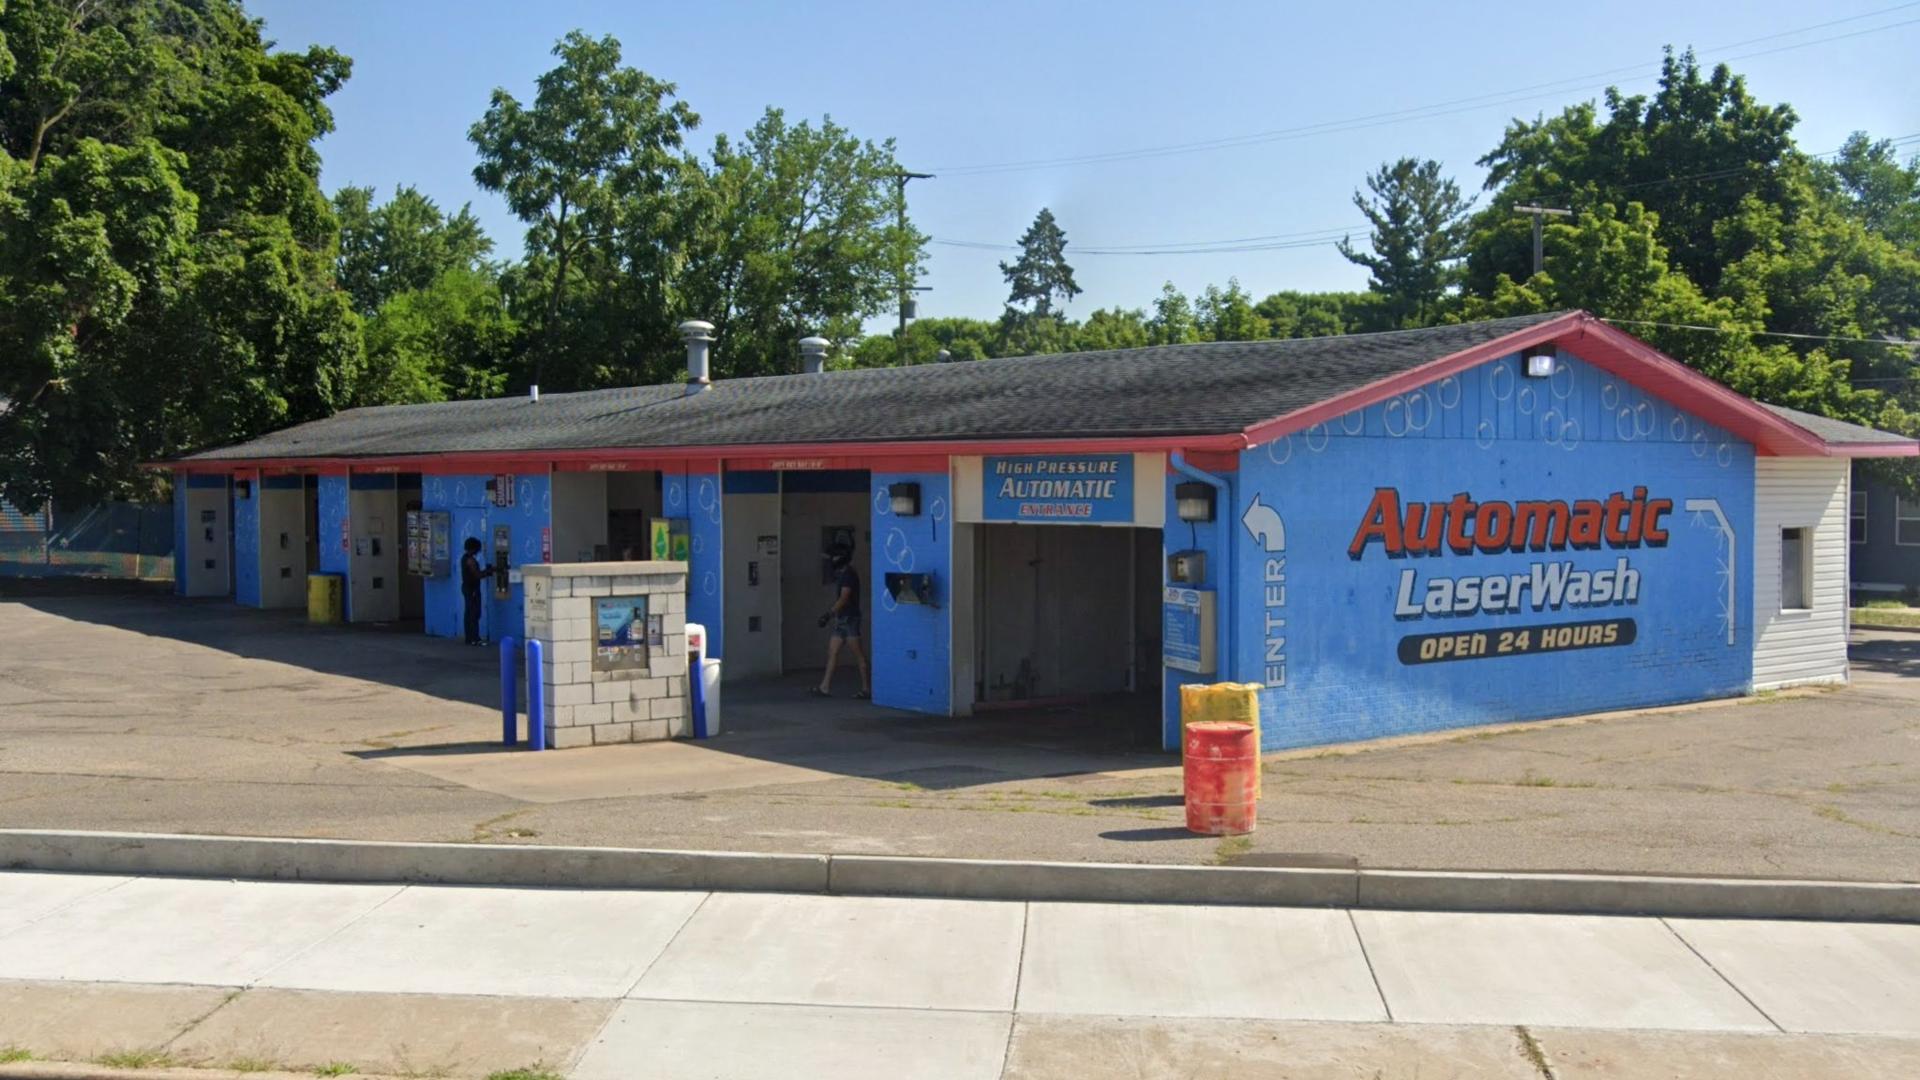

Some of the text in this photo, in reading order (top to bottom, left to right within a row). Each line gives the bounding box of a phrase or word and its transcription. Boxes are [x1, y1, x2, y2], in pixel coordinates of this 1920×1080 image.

[996, 460, 1119, 474] HIGH PRESSURE
[999, 478, 1117, 498] AUTOMATIC
[1019, 503, 1092, 517] ENTRANCE
[1347, 486, 1674, 560] Automatic
[1394, 556, 1641, 621] LaserWash
[1265, 555, 1286, 689] ENTER
[1420, 623, 1619, 660] OPEN 24 HOURS
